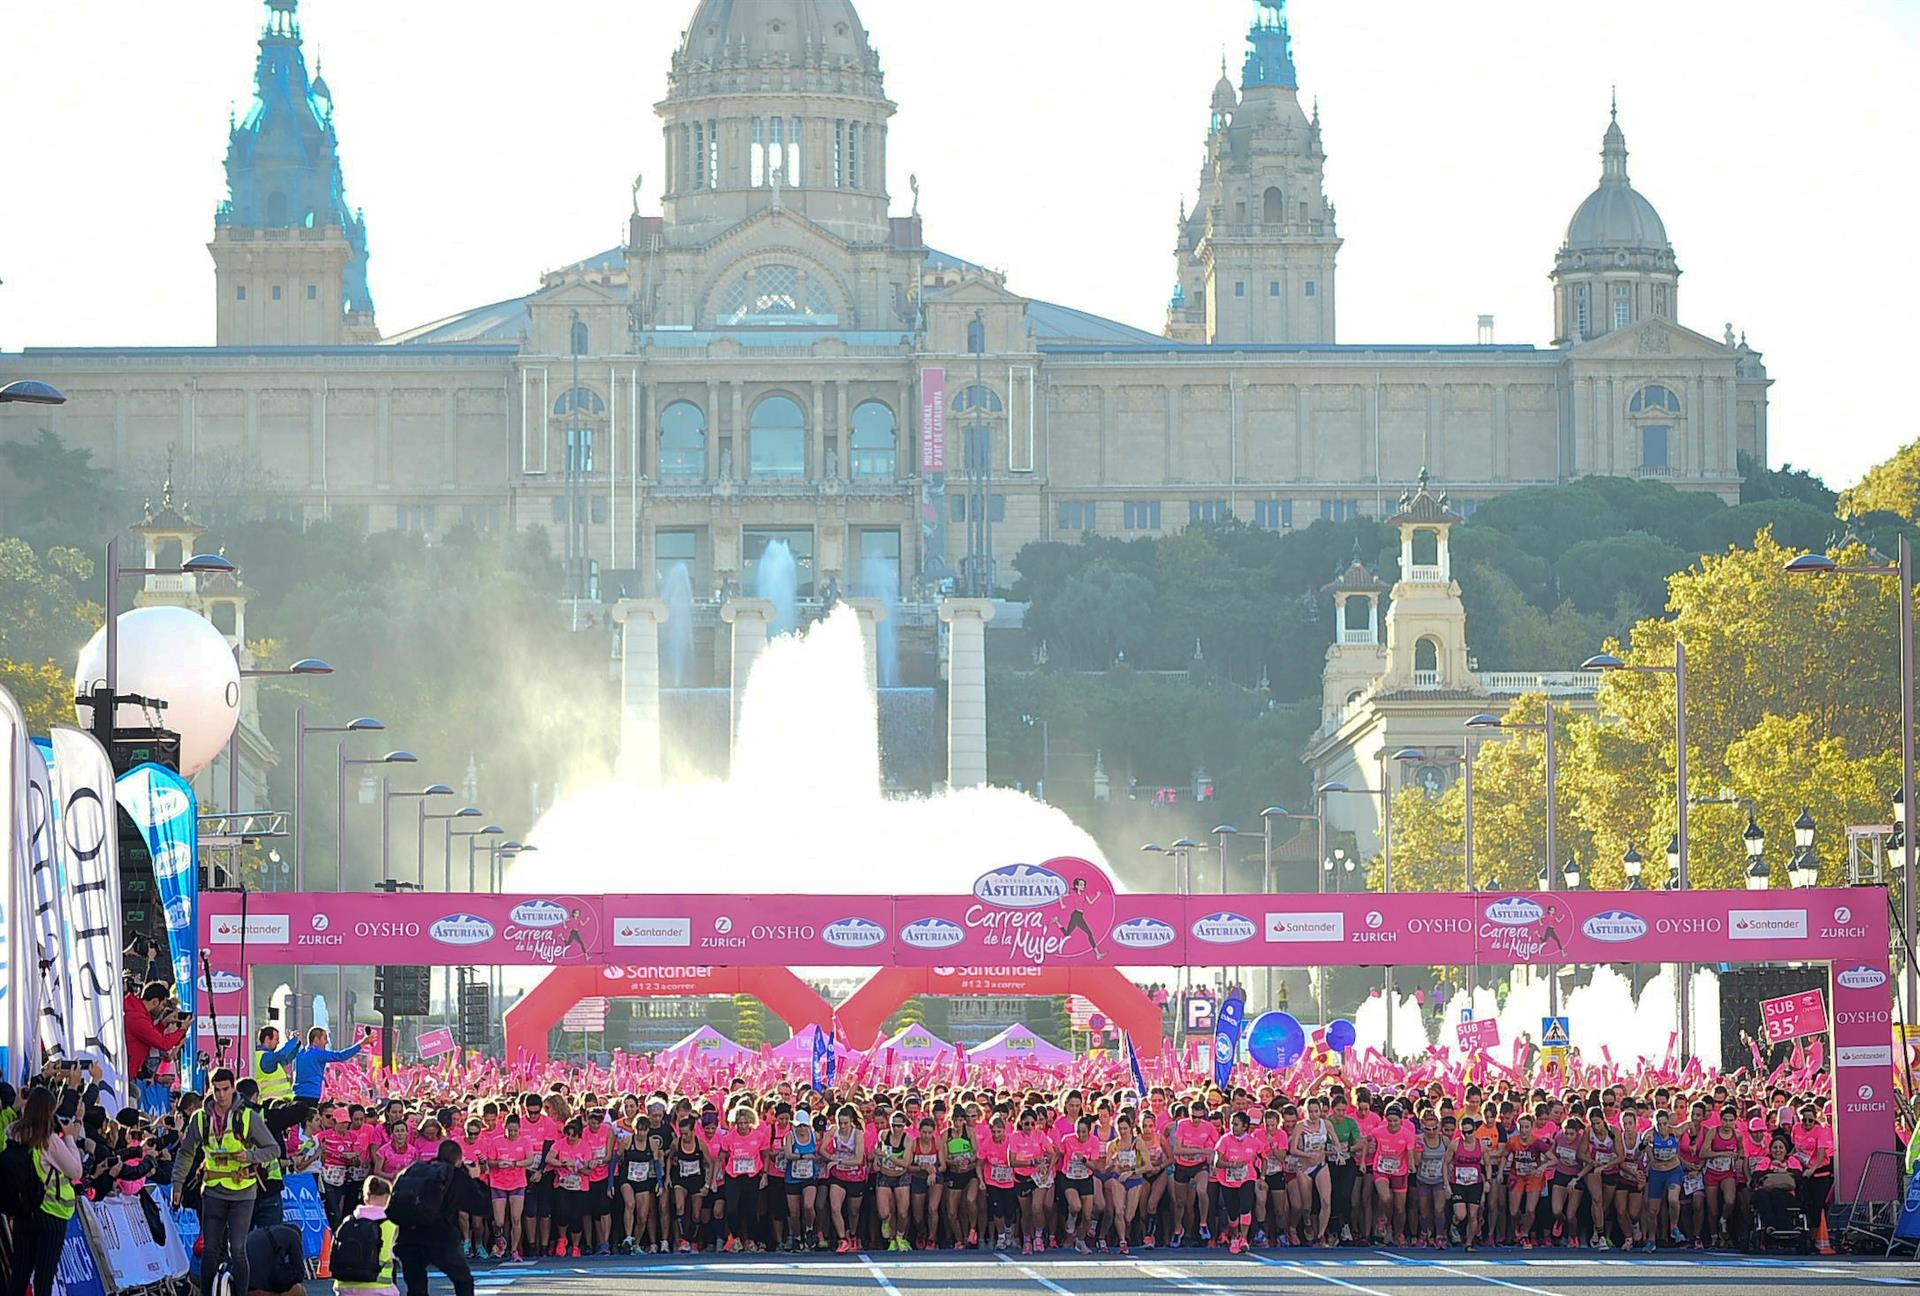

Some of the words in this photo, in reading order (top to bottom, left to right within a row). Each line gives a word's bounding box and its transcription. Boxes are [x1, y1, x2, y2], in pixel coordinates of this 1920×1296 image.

[934, 390, 943, 432] CATALUNYA
[924, 403, 933, 440] NACIONAL
[981, 879, 1061, 897] ASTURIANA
[514, 909, 564, 921] ASTURIANA
[965, 904, 1043, 928] Carrera
[1489, 907, 1540, 919] ASTURIANA
[231, 925, 281, 934] Santander
[354, 922, 420, 937] OYSHO
[1197, 924, 1252, 936] ASTURIANA
[1286, 922, 1336, 932] Santander
[1408, 918, 1472, 933] OYSHO
[1480, 923, 1529, 938] Carrera
[1587, 922, 1643, 934] ASTURIANA
[1655, 918, 1721, 933] OYSHO
[1750, 919, 1800, 930] Santander
[433, 925, 490, 938] ASTURIANA
[503, 925, 553, 941] Carrera
[634, 927, 683, 937] Santander
[751, 925, 815, 940] OYSHO
[827, 929, 881, 941] ASTURIANA
[905, 929, 960, 941] ASTURIANA
[1117, 929, 1171, 941] ASTURIANA
[1352, 932, 1397, 942] ZURICH
[1820, 927, 1865, 938] ZURICH
[298, 935, 343, 945] ZURICH
[700, 937, 746, 948] ZURICH
[983, 930, 998, 945] de
[1001, 929, 1012, 945] la
[1009, 925, 1071, 964] Mujer
[515, 941, 525, 951] de
[526, 941, 534, 951] la
[531, 939, 571, 963] Mujer
[1491, 938, 1501, 949] de
[1502, 938, 1510, 949] la
[1508, 937, 1547, 961] Mujer
[626, 965, 713, 979] Santander
[1840, 973, 1883, 984] ASTURIANA
[1188, 999, 1212, 1028] P
[1766, 1000, 1795, 1016] SUB
[1836, 1010, 1889, 1024] OYSHO
[1458, 1023, 1479, 1035] SUB
[1851, 1052, 1886, 1060] Santander
[1847, 1102, 1886, 1112] ZURICH
